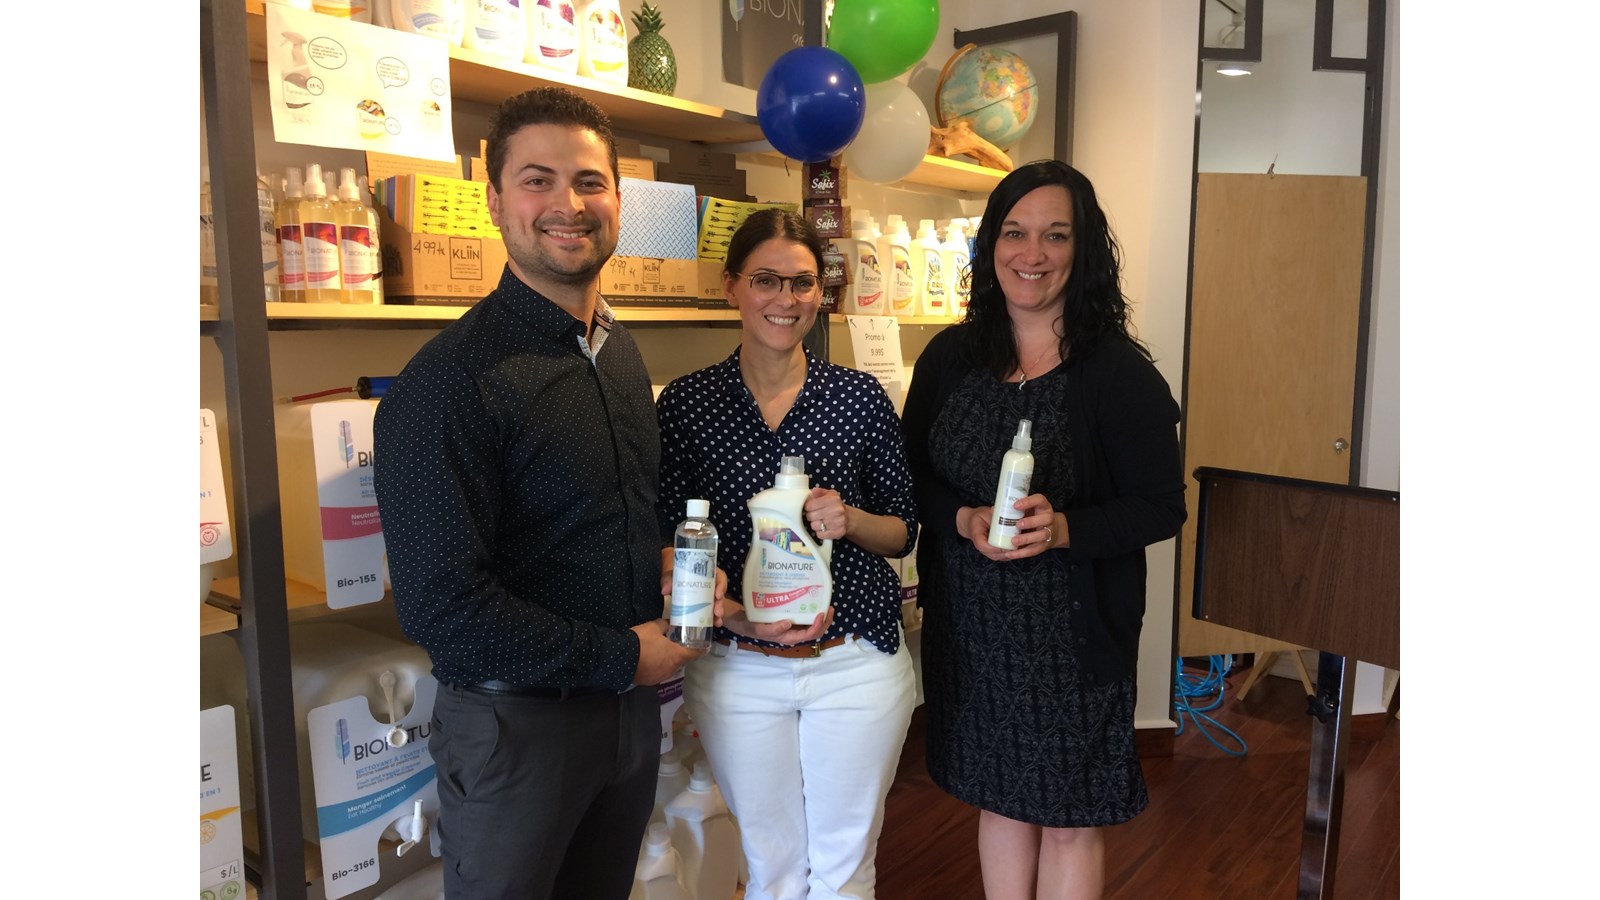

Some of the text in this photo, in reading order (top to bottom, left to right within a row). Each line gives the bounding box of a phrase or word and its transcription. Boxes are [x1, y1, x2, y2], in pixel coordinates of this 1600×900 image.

[811, 178, 835, 191] Safix
[815, 218, 838, 231] Safix
[824, 267, 844, 279] Safix
[768, 562, 814, 571] BIONATURE
[337, 573, 377, 588] Bio-155
[677, 581, 711, 589] BIONATURE
[766, 594, 790, 604] ULTRA
[356, 757, 393, 774] NETTOYANT
[347, 784, 407, 813] Manger sainement
[332, 858, 375, 881] Bio-3166
